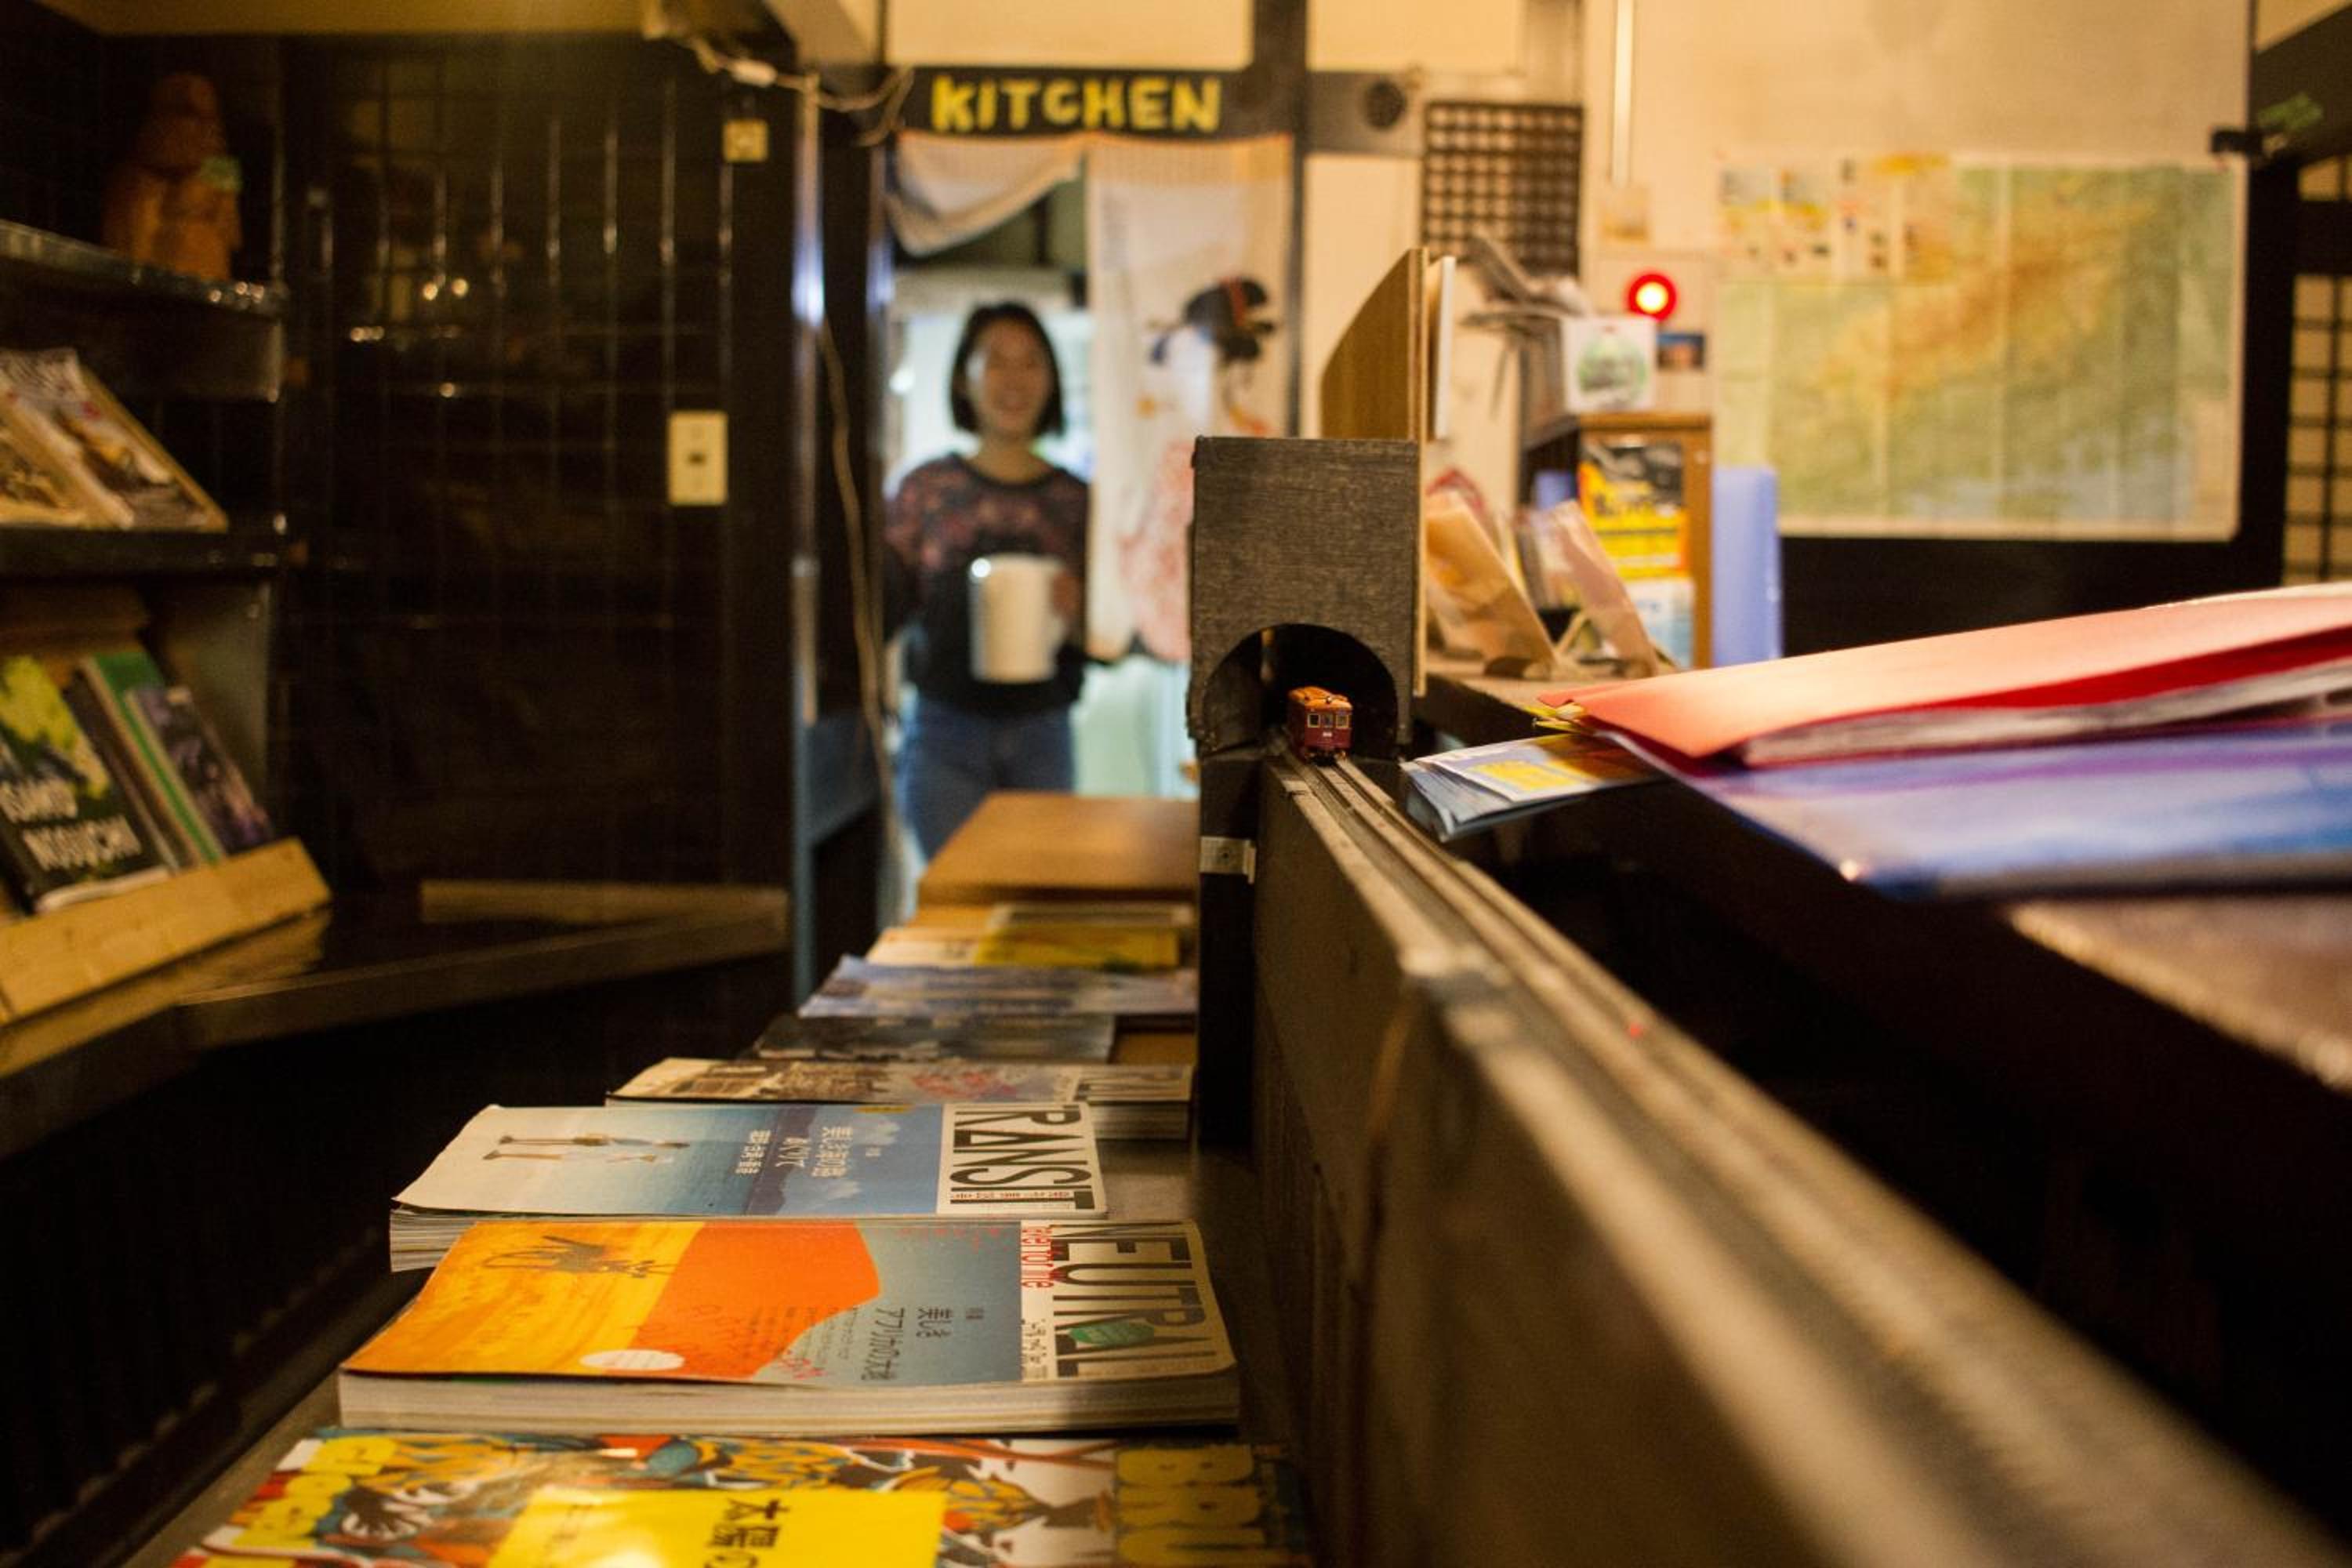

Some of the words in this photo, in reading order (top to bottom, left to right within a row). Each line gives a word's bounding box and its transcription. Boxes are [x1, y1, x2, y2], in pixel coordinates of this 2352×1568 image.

[931, 74, 1221, 132] KITCHEN
[950, 1105, 1096, 1210] TRANSIT
[916, 1307, 953, 1338] 美しき
[1050, 1221, 1217, 1377] NEUTRAL
